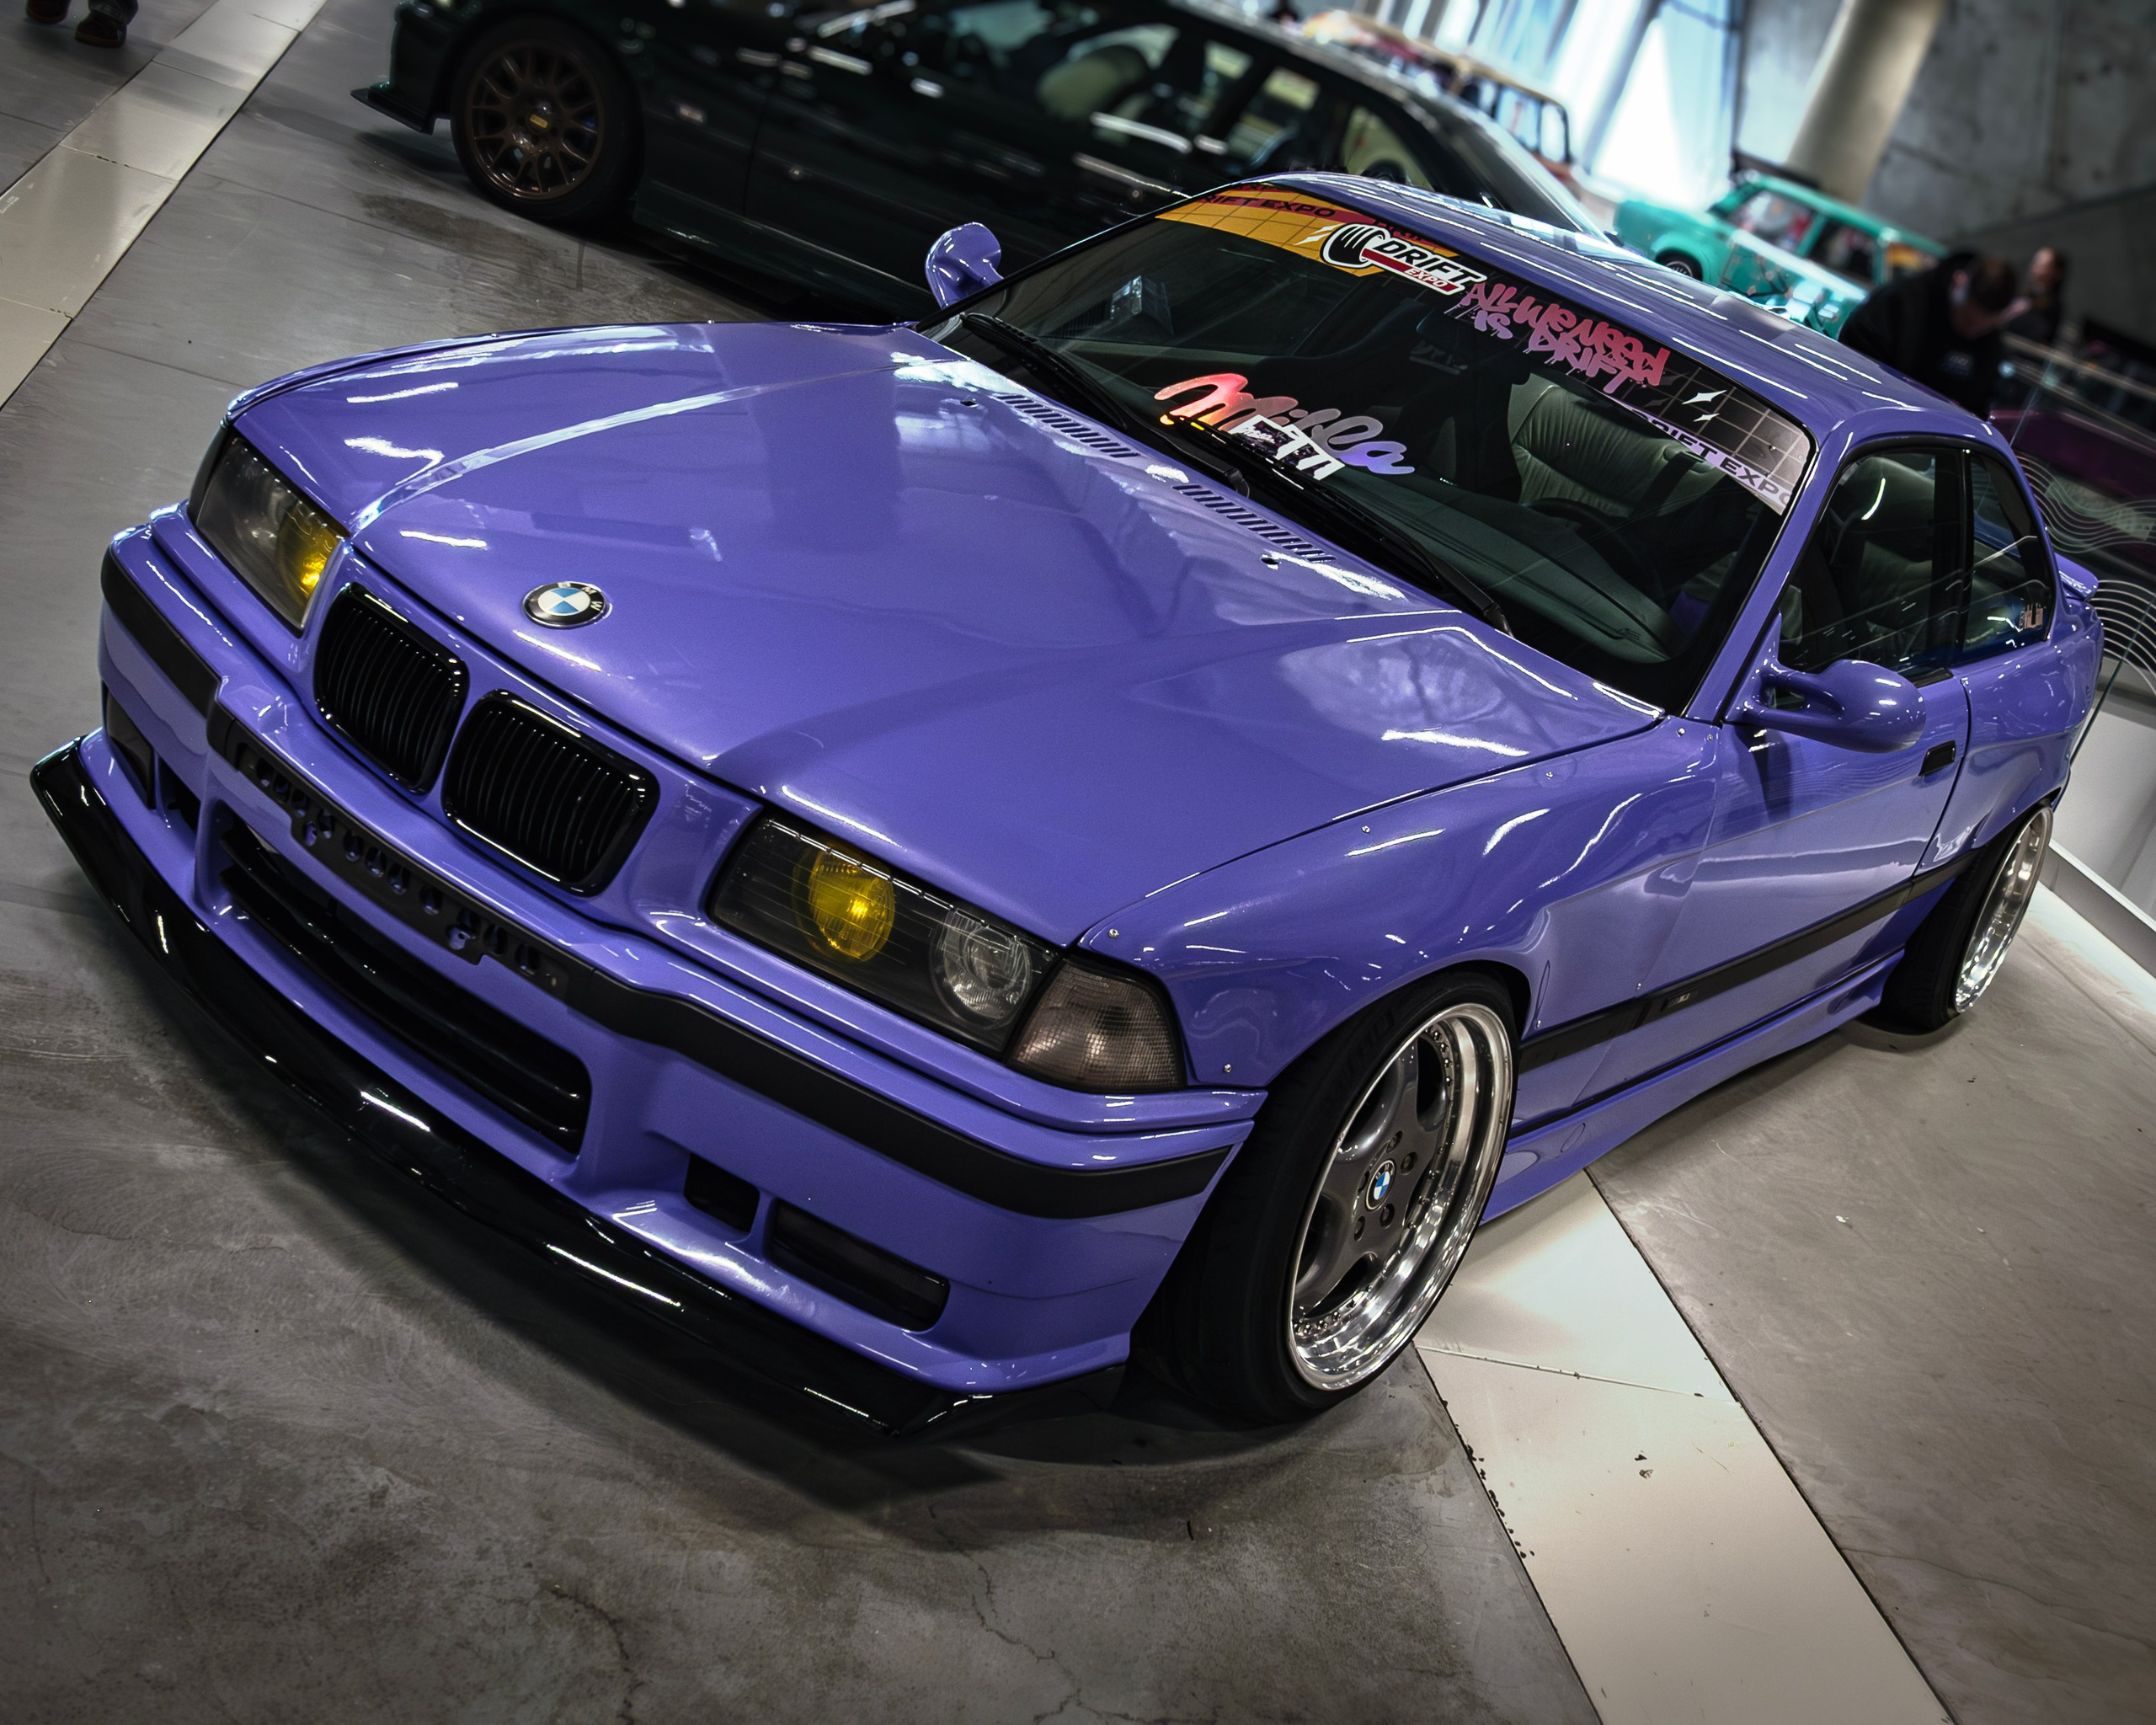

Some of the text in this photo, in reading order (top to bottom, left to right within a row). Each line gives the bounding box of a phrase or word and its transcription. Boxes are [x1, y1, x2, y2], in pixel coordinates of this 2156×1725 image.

[1203, 195, 1336, 217] RIFT EXPO
[1372, 239, 1482, 284] DRIFT
[1404, 268, 1449, 288] EXPO
